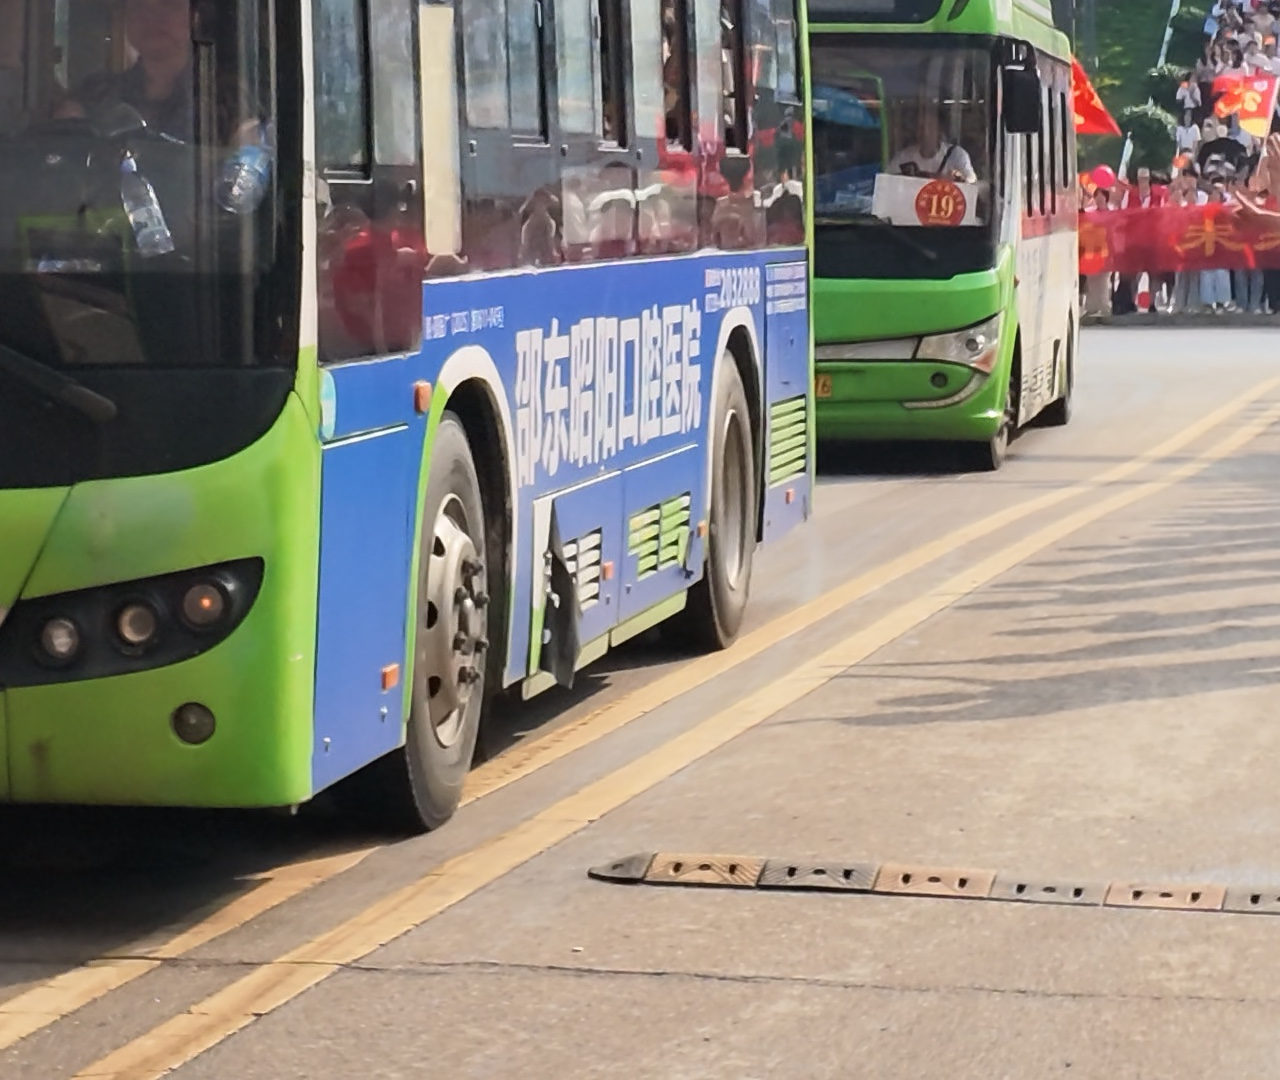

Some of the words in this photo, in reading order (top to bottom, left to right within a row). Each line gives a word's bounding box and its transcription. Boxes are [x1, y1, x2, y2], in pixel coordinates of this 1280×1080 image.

[928, 193, 955, 219] 19
[515, 298, 702, 488] 邵东昭阳口腔医院
